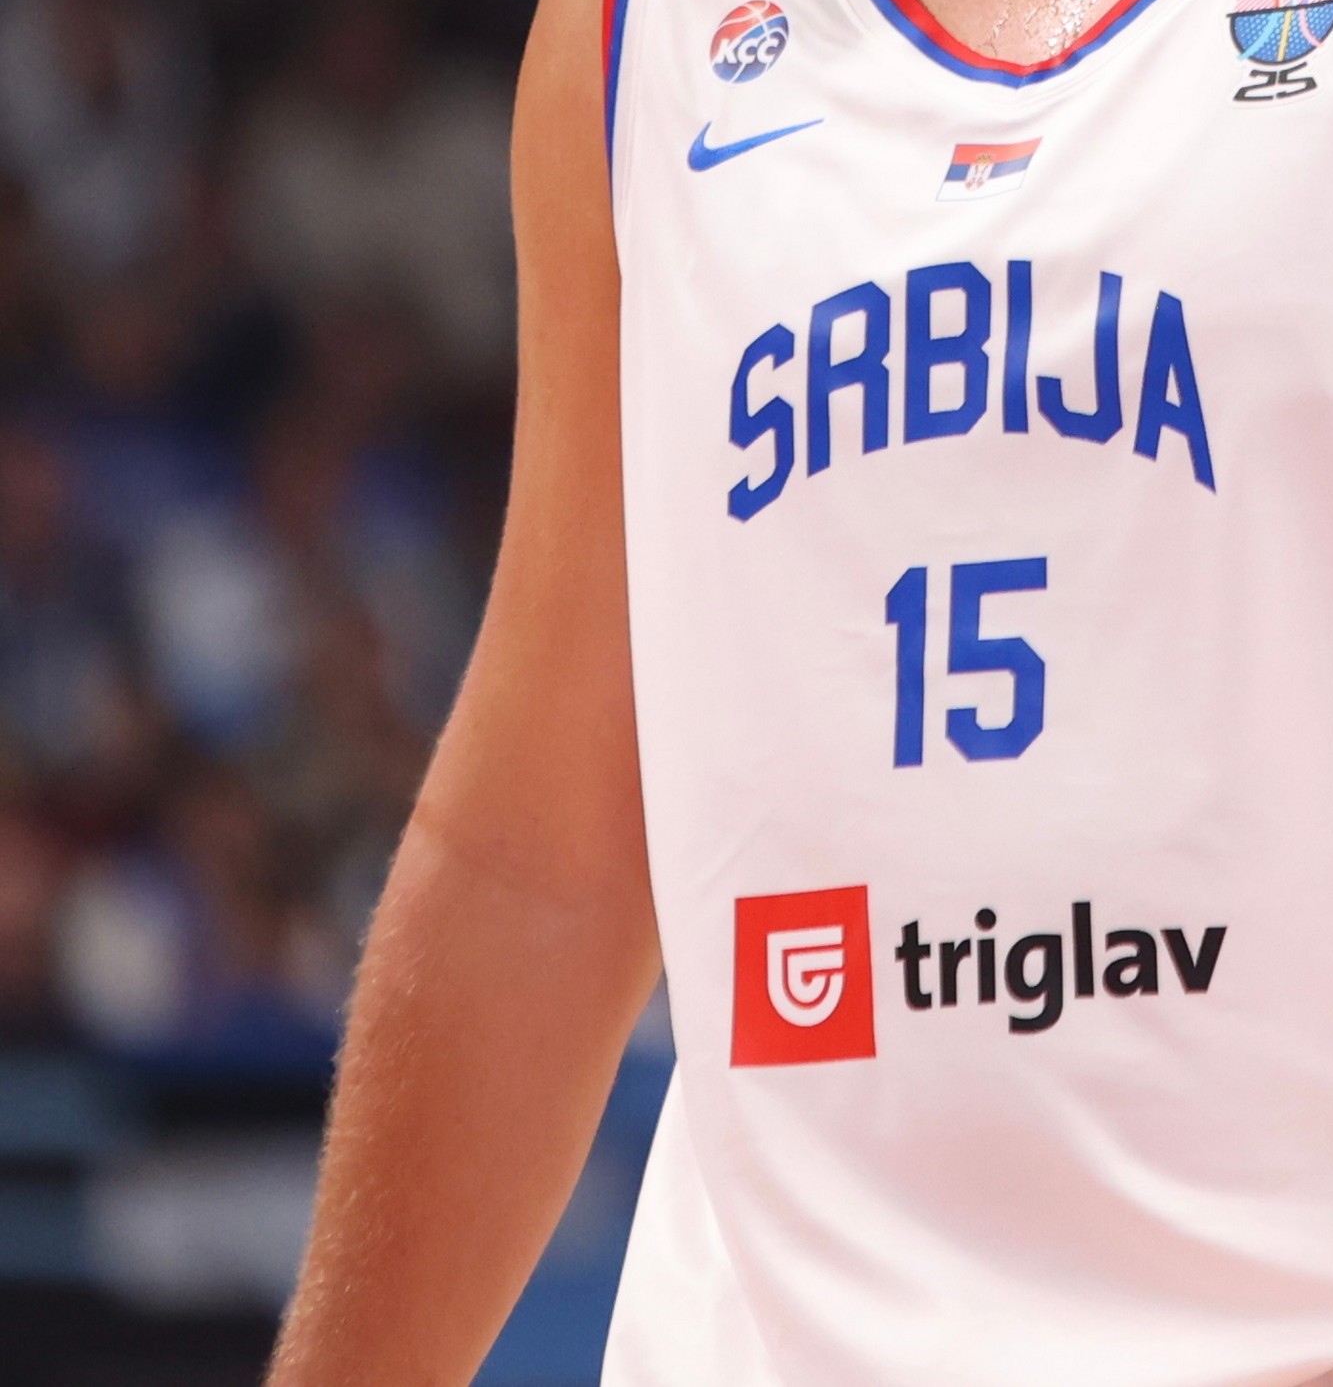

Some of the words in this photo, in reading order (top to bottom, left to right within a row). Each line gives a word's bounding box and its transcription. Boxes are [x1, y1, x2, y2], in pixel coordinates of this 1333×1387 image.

[727, 259, 1217, 523] SRBIJA
[884, 555, 1048, 769] 15
[894, 900, 1228, 1035] triglav
